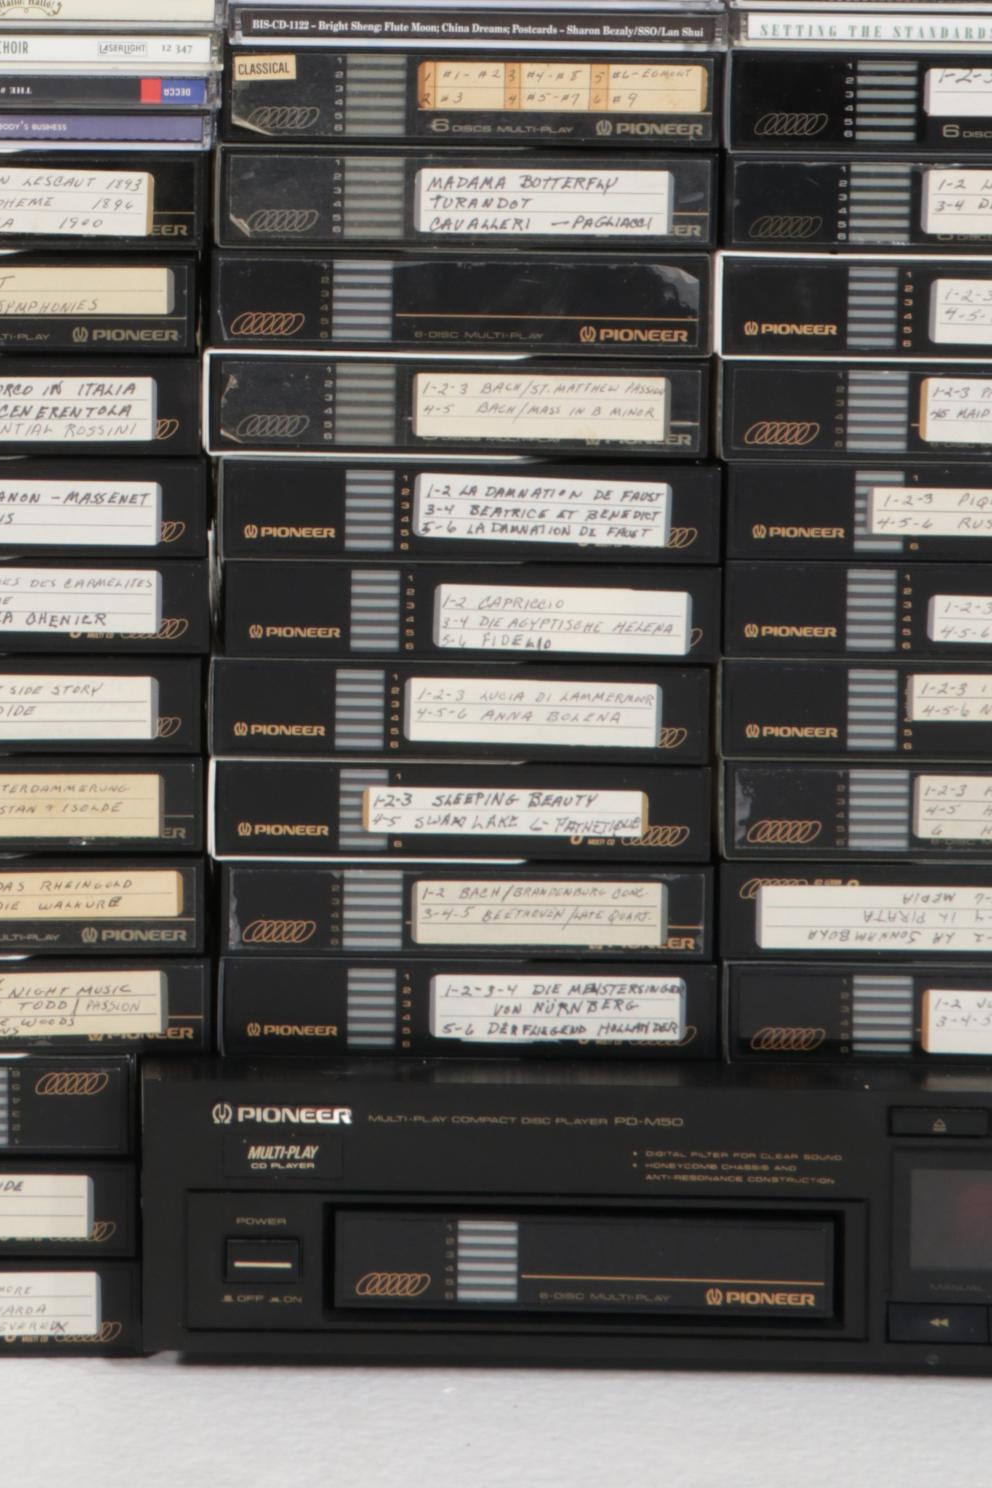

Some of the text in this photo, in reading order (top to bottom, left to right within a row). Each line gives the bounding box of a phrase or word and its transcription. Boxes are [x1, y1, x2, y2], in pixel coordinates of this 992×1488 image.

[238, 61, 290, 75] CLASSICAL
[92, 329, 179, 342] PIONEER
[600, 329, 688, 342] PIONEER
[762, 323, 837, 335] PIONEER
[237, 1107, 352, 1125] PIONEER
[247, 1143, 319, 1161] MULTI-PLAY
[236, 1217, 286, 1226] POWER
[726, 1292, 815, 1307] PIONEER
